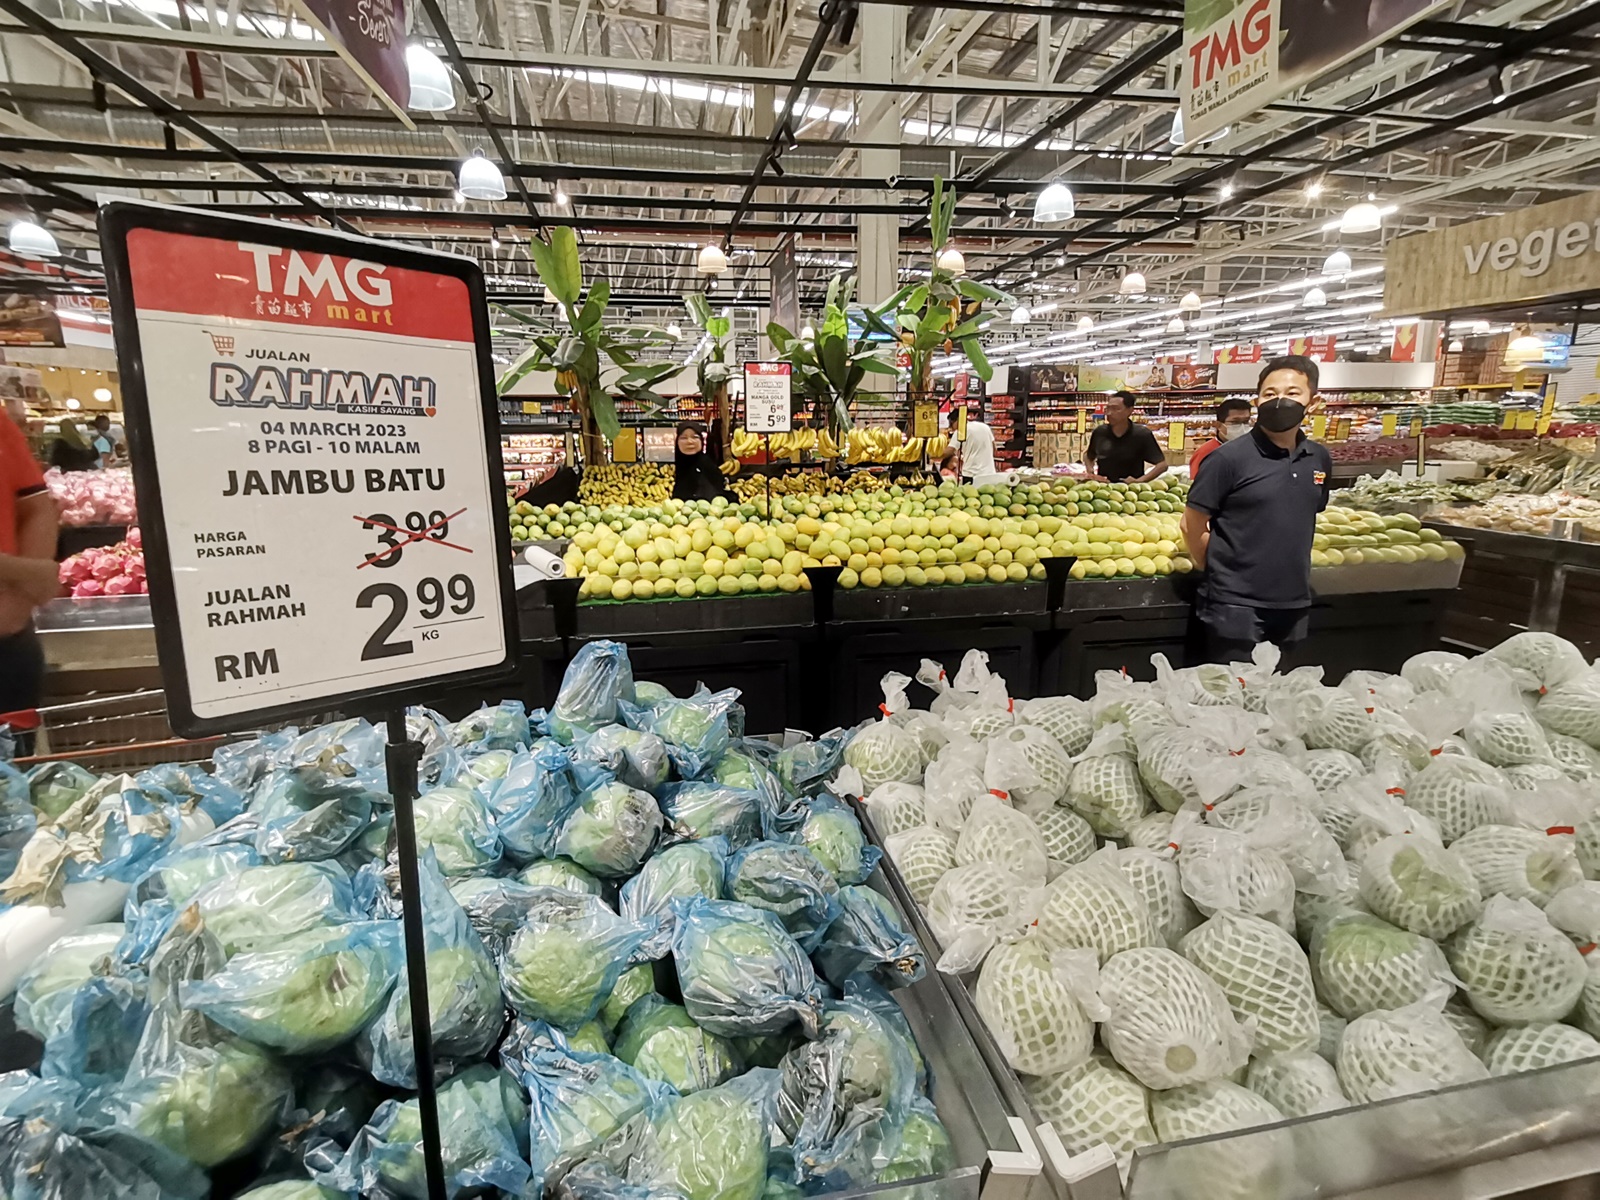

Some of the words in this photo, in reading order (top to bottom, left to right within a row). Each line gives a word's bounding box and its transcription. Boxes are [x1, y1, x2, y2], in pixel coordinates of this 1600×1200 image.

[1189, 0, 1271, 89] TMG
[1228, 50, 1268, 88] mart
[1228, 72, 1269, 102] SUPERMARKET
[238, 241, 393, 307] TMG
[327, 304, 394, 326] mart
[245, 349, 311, 363] JUALAN
[210, 362, 437, 410] RAHMAH
[347, 405, 378, 414] KASIH
[380, 406, 417, 416] SAYANG
[260, 421, 286, 436] 04
[291, 421, 360, 436] MARCH
[365, 423, 407, 437] 2023
[248, 440, 261, 454] 8
[265, 440, 312, 454] PAGI
[328, 441, 351, 454] 10
[355, 441, 421, 454] MALAM
[222, 469, 355, 497] JAMBU
[365, 468, 446, 493] BATU
[194, 531, 248, 544] HARGA
[196, 544, 267, 559] PASARAN
[204, 584, 292, 607] JUALAN
[207, 602, 307, 628] RAHMAH
[421, 629, 440, 642] KG
[214, 648, 280, 683] RM
